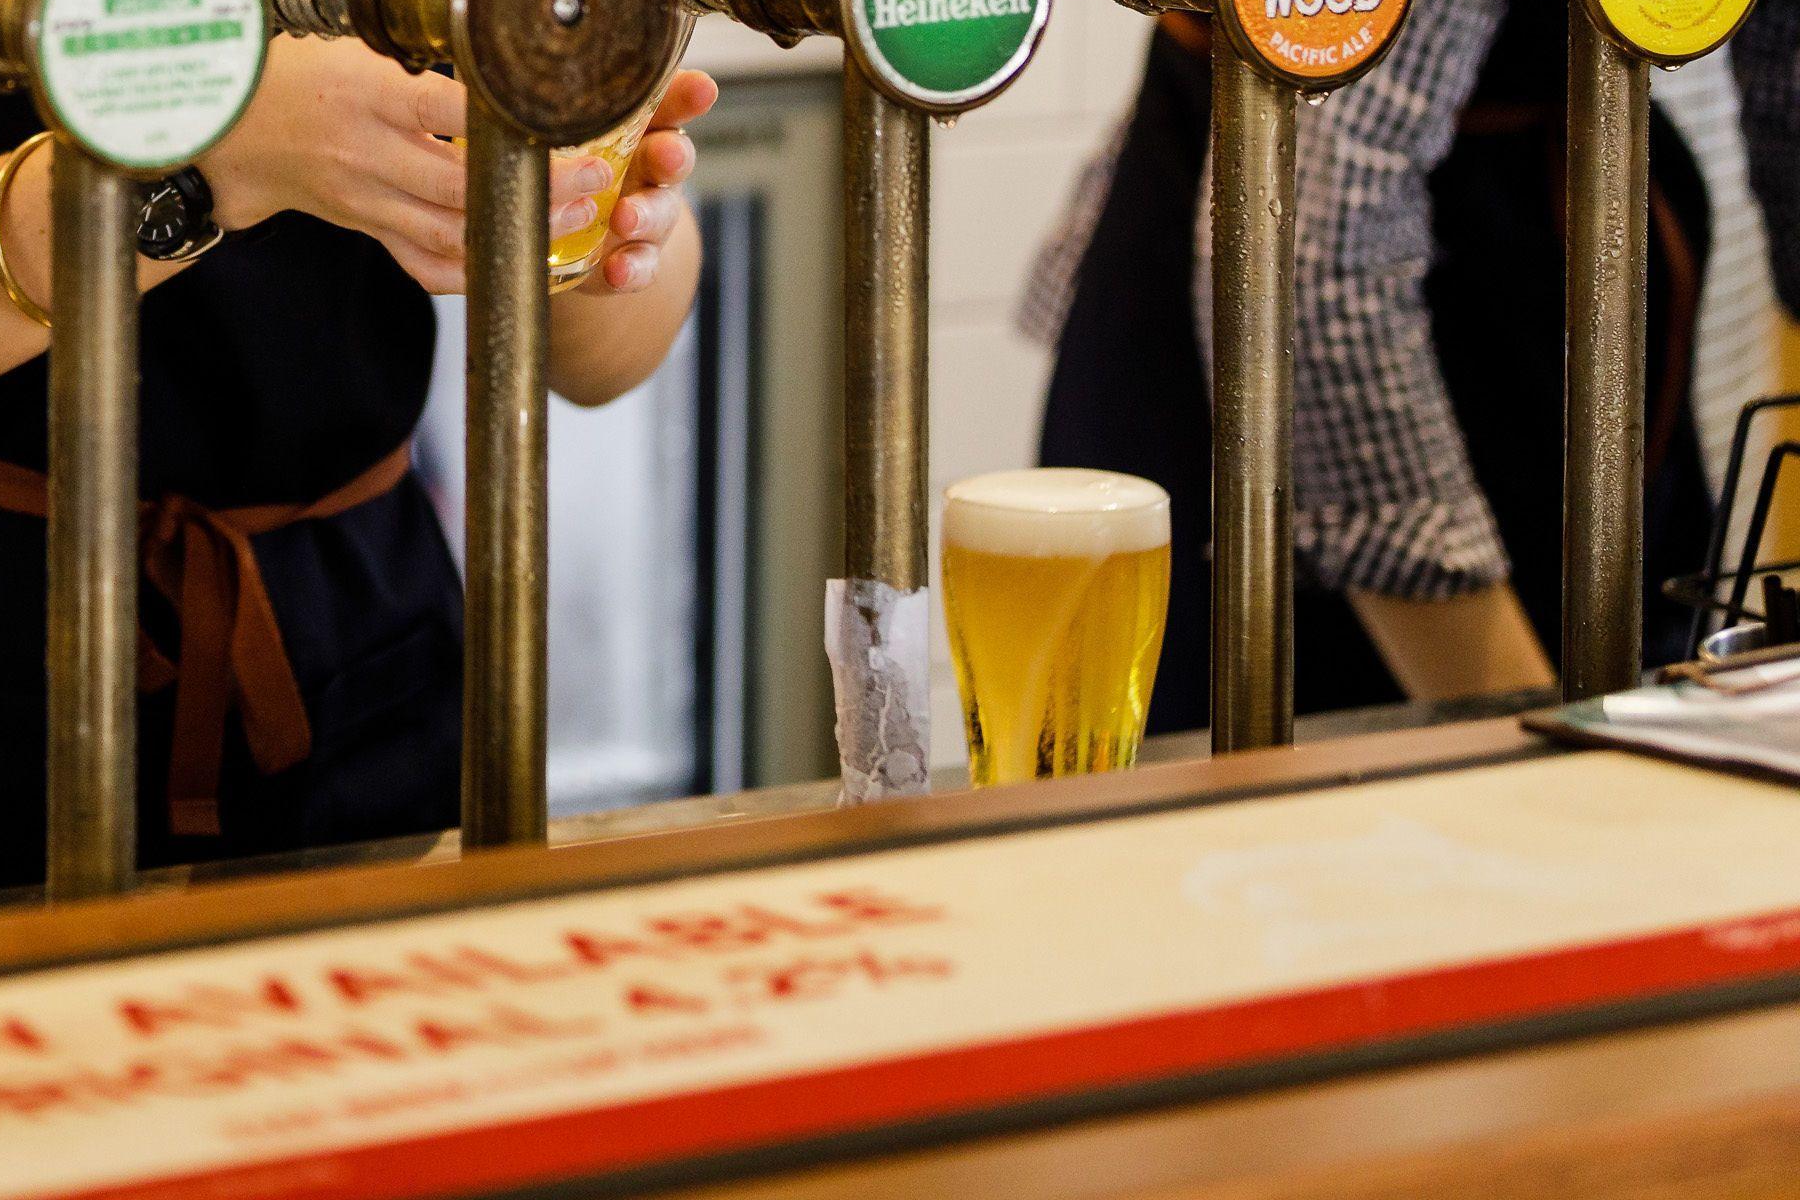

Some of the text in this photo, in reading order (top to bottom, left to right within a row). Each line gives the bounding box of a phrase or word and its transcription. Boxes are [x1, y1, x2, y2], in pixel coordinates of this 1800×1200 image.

[1268, 25, 1374, 65] PACIFIC ALE
[116, 887, 948, 1040] AVAILABLE
